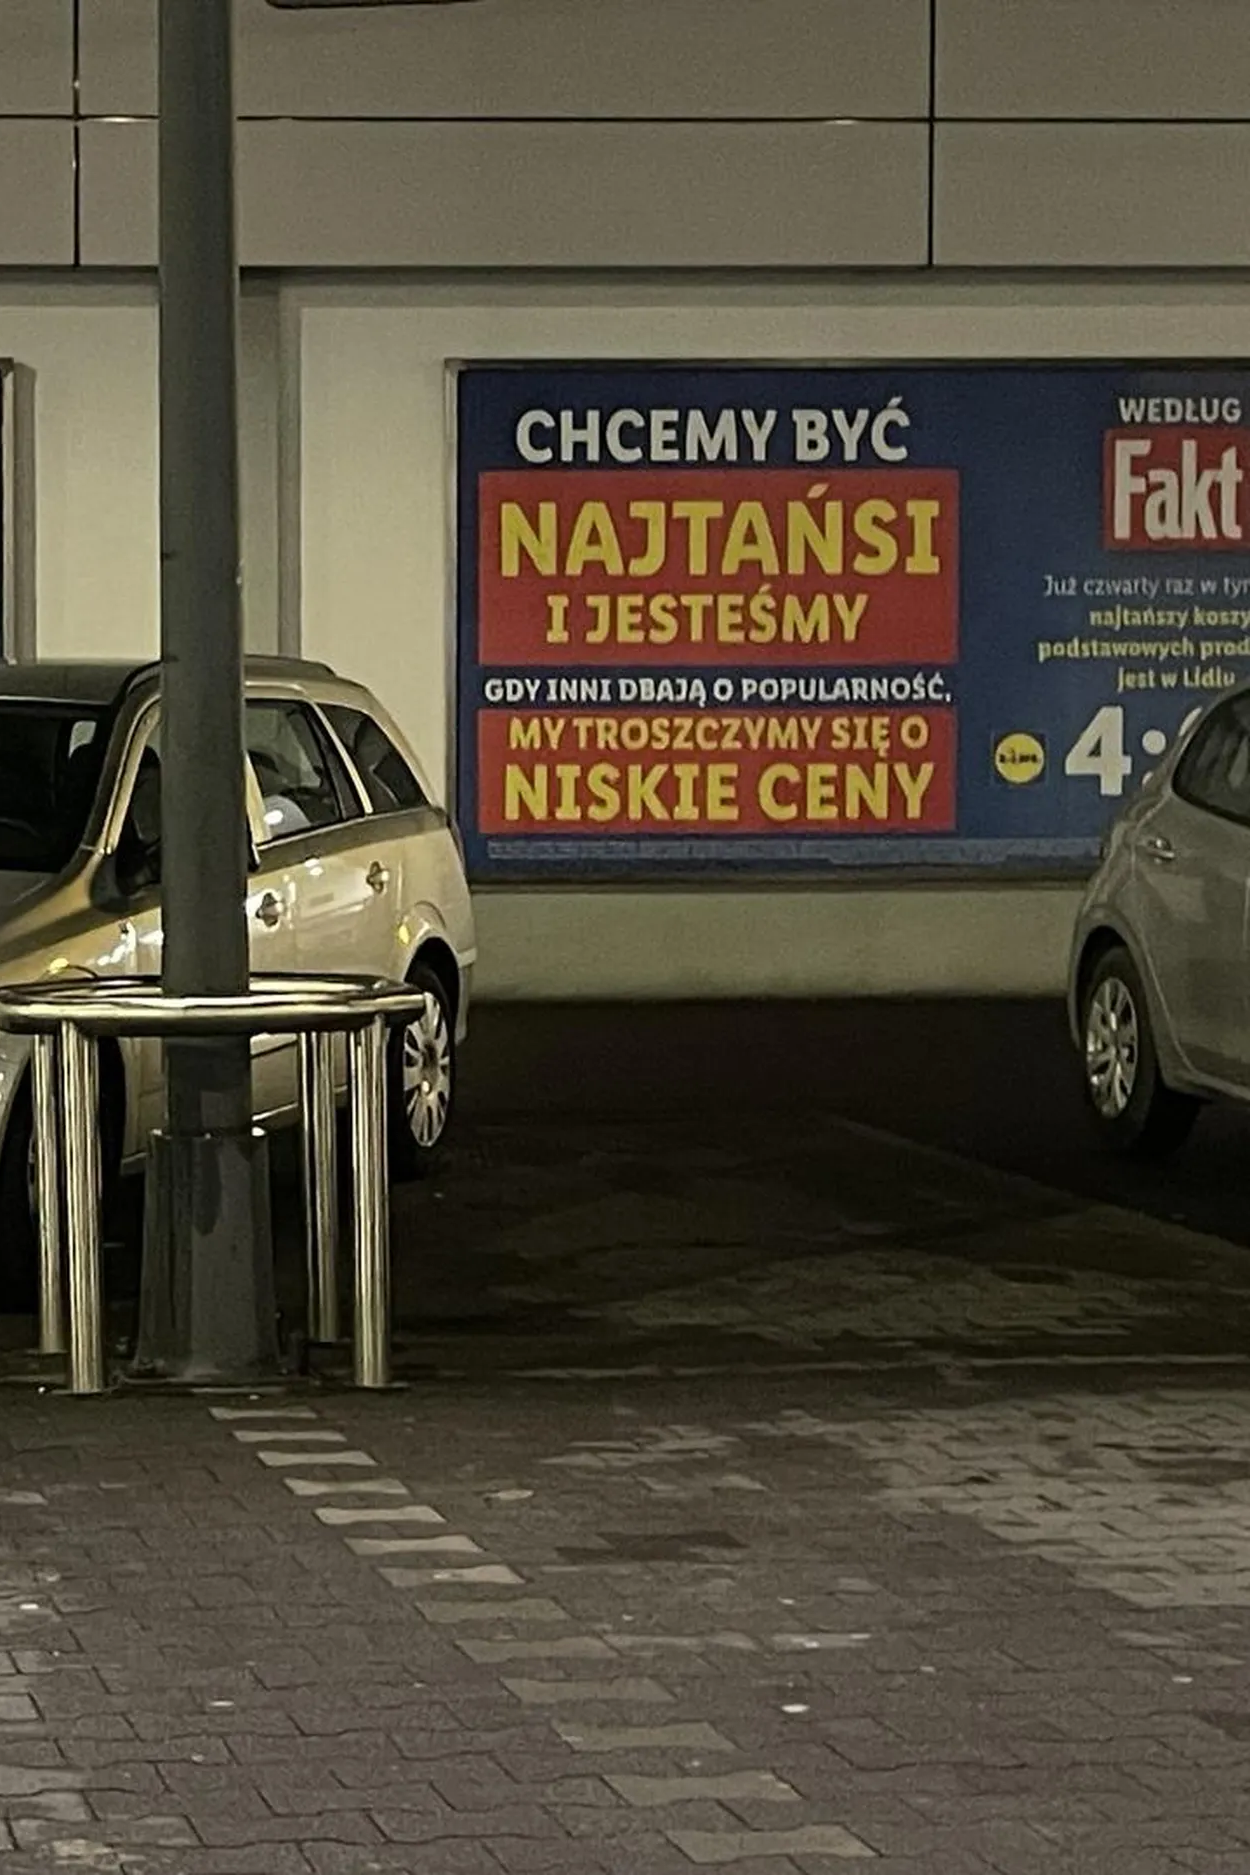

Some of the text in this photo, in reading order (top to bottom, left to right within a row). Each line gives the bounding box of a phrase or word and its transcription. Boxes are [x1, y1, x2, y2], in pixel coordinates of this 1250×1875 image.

[1118, 397, 1242, 423] WEDŁUG
[515, 396, 911, 463] CHCEMY BYĆ
[1114, 438, 1244, 541] Fakt
[500, 482, 942, 578] NAJTAŃSI
[1083, 577, 1160, 599] czwarty
[1166, 577, 1195, 596] raz
[1200, 578, 1217, 595] w
[546, 585, 869, 645] I JESTEŚMY
[1089, 604, 1189, 632] najtańszy
[1038, 636, 1195, 664] podstawowych
[485, 673, 952, 708] GDY INNI DBAJĄ O POPULARNOŚĆ,
[1117, 666, 1236, 694] jest w Lidlu
[509, 716, 929, 758] MY TROSZCZYMY SIĘ O
[504, 762, 935, 822] NISKIE CENY
